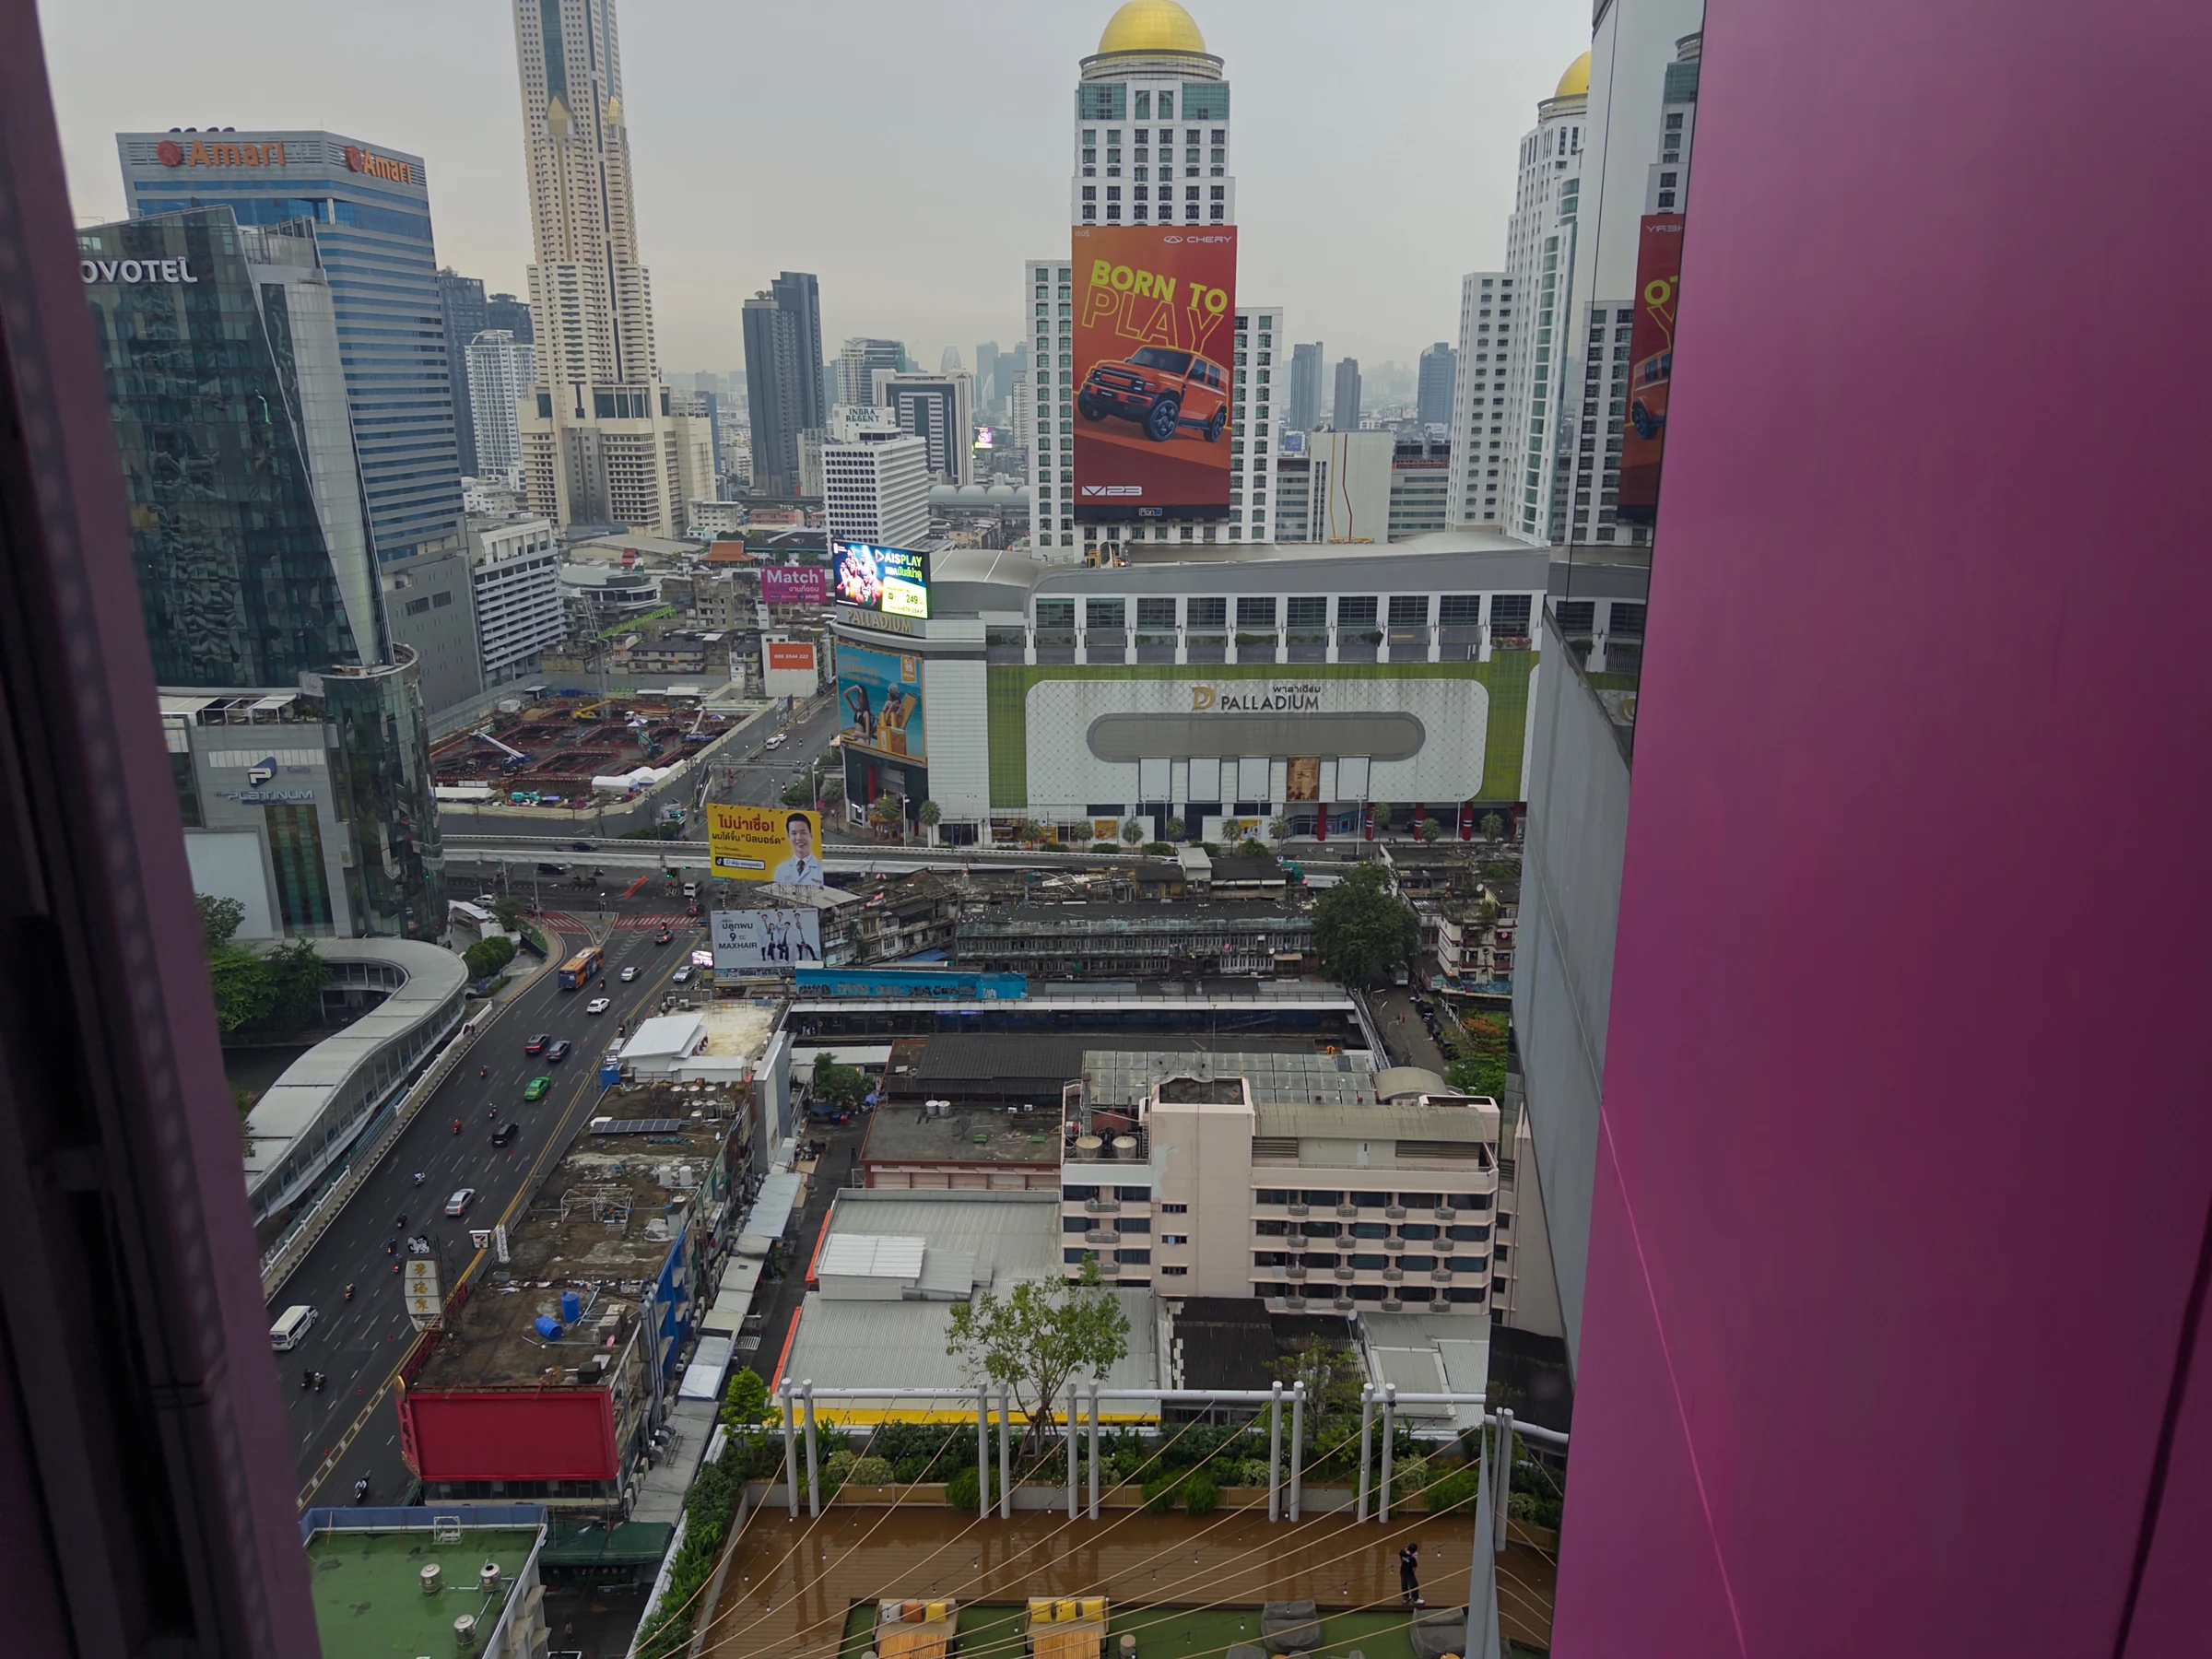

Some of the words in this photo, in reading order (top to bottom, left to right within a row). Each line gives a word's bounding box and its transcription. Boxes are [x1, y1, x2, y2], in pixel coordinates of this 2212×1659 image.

[188, 139, 286, 167] Amari
[363, 148, 412, 183] Amari
[80, 256, 198, 283] OVOTEL
[1091, 259, 1176, 302] BORN
[1190, 282, 1228, 313] TO
[1081, 283, 1224, 354] PLAY
[849, 407, 876, 416] INDRA
[767, 569, 819, 583] Match
[847, 609, 912, 633] PALLADIUM
[1221, 693, 1319, 711] PALLADIUM
[718, 813, 774, 832] ไม่น่าเชื่อ!
[729, 932, 736, 942] 9
